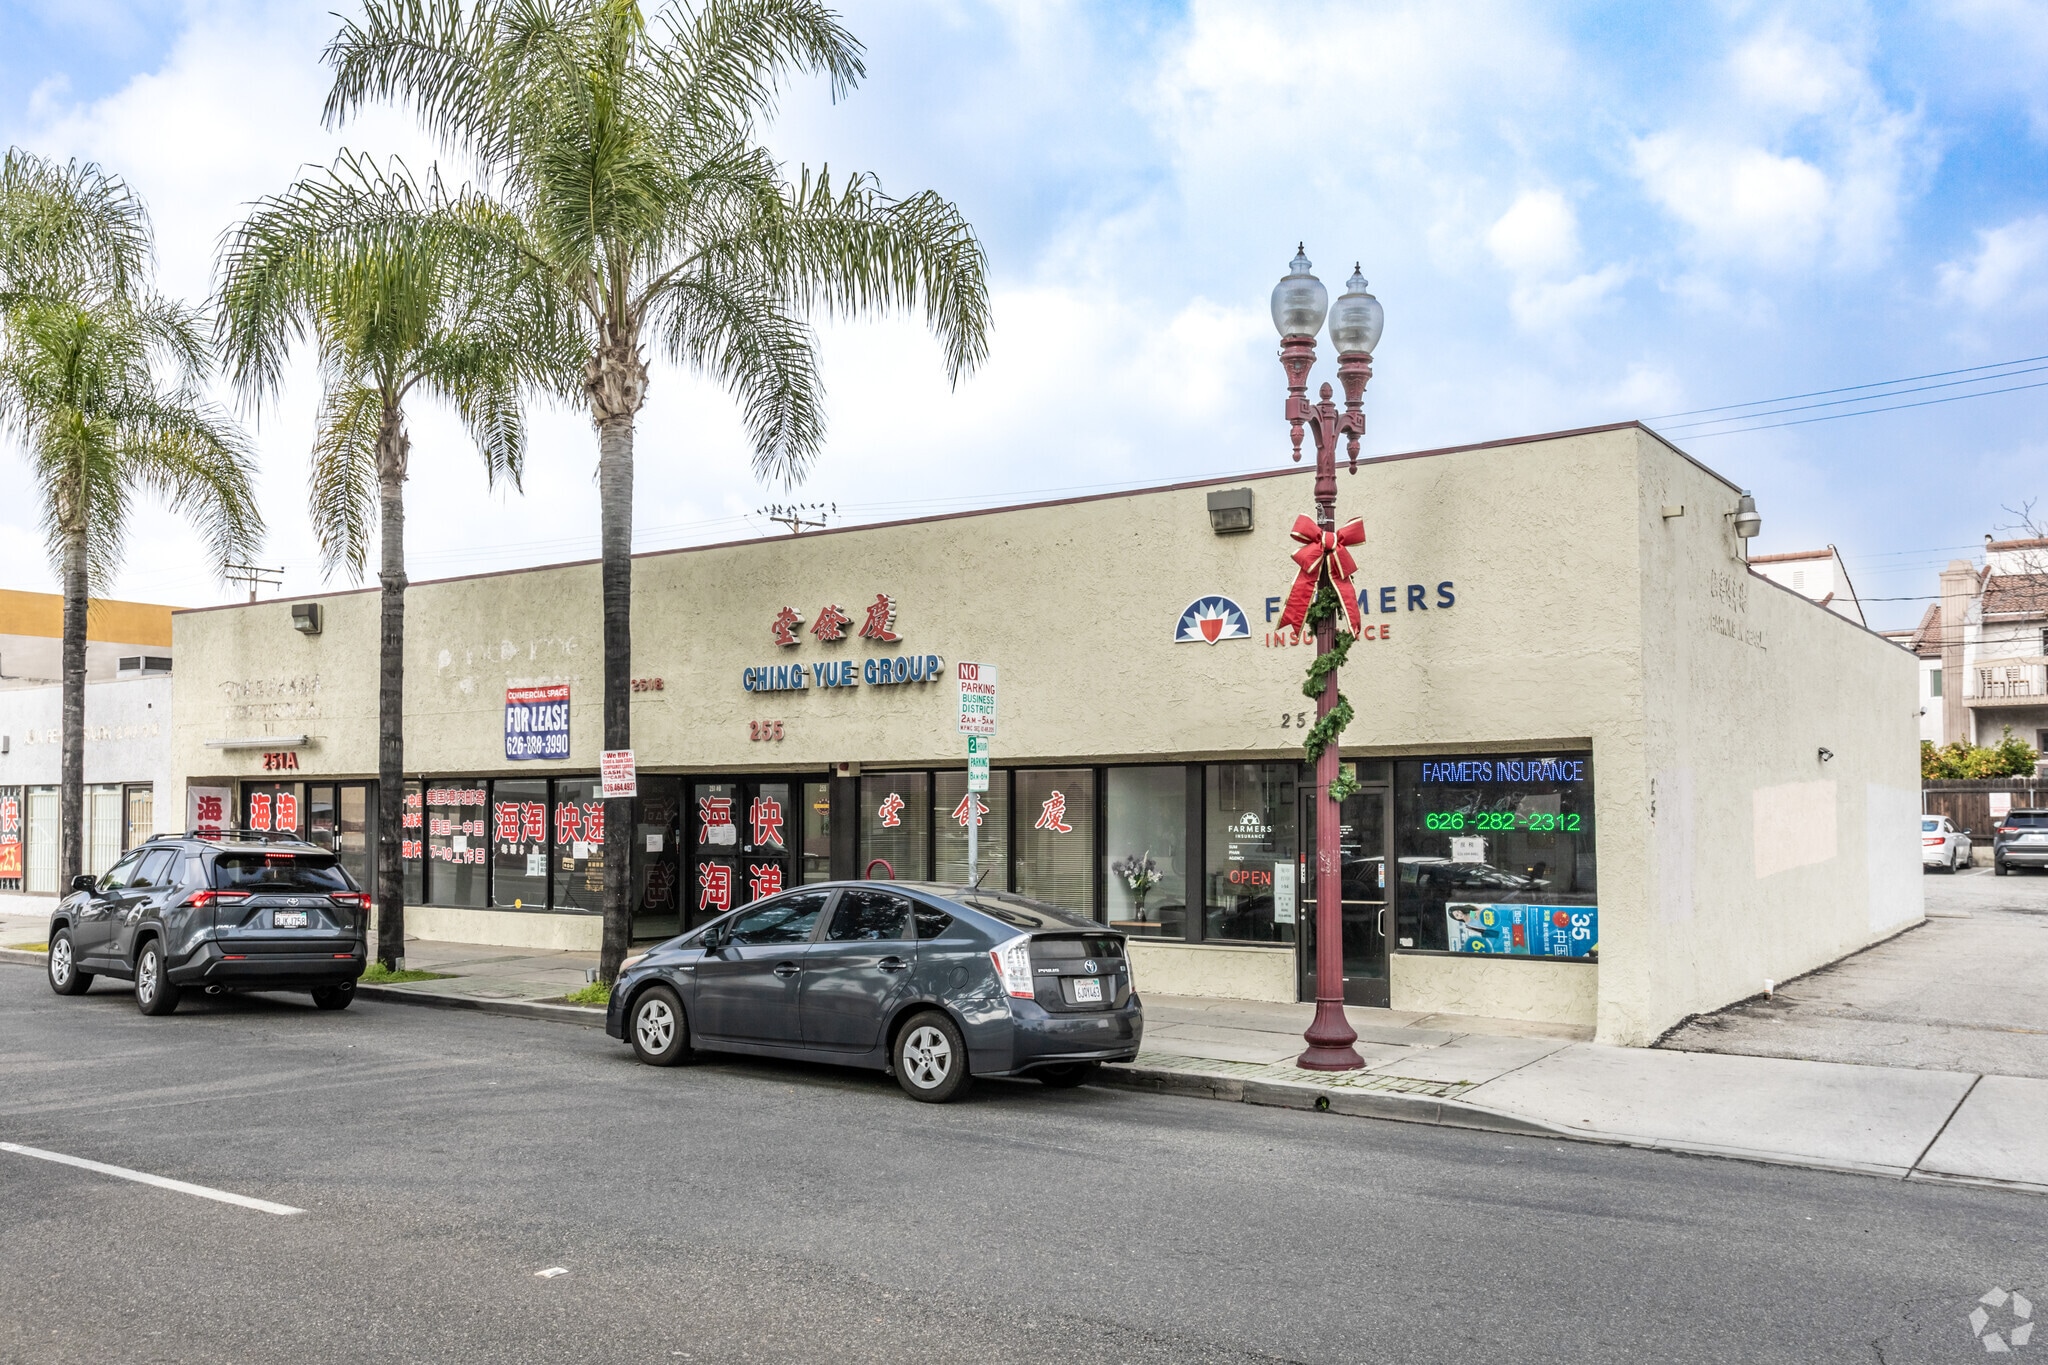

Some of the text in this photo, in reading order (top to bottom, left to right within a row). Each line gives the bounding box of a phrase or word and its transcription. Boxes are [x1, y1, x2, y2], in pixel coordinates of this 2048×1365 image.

[1265, 581, 1456, 622] FERS
[1265, 624, 1391, 647] INSUCE
[742, 654, 944, 693] CHING YUE GROUP
[960, 664, 977, 680] NO
[508, 688, 568, 700] COMMERCIAL SPACE
[961, 682, 995, 695] PARKING
[962, 694, 994, 704] BUSINESS
[962, 704, 994, 714] DISTRICT
[507, 704, 568, 733] FOR LEASE
[1281, 711, 1317, 729] 25
[750, 720, 785, 741] 255
[506, 734, 568, 755] 626-888-3990
[970, 739, 987, 751] 2 HOUR
[262, 752, 299, 770] 251A
[970, 757, 988, 768] PARKING
[1422, 761, 1583, 782] FARMERS INSURANCE
[250, 792, 297, 832] 海淘
[878, 792, 904, 827] 堂
[1034, 790, 1072, 833] 慶
[495, 801, 546, 843] 海淘
[1228, 825, 1272, 833] FARMERS
[1426, 812, 1580, 831] 626-282-2312
[1229, 869, 1271, 885] OPEN
